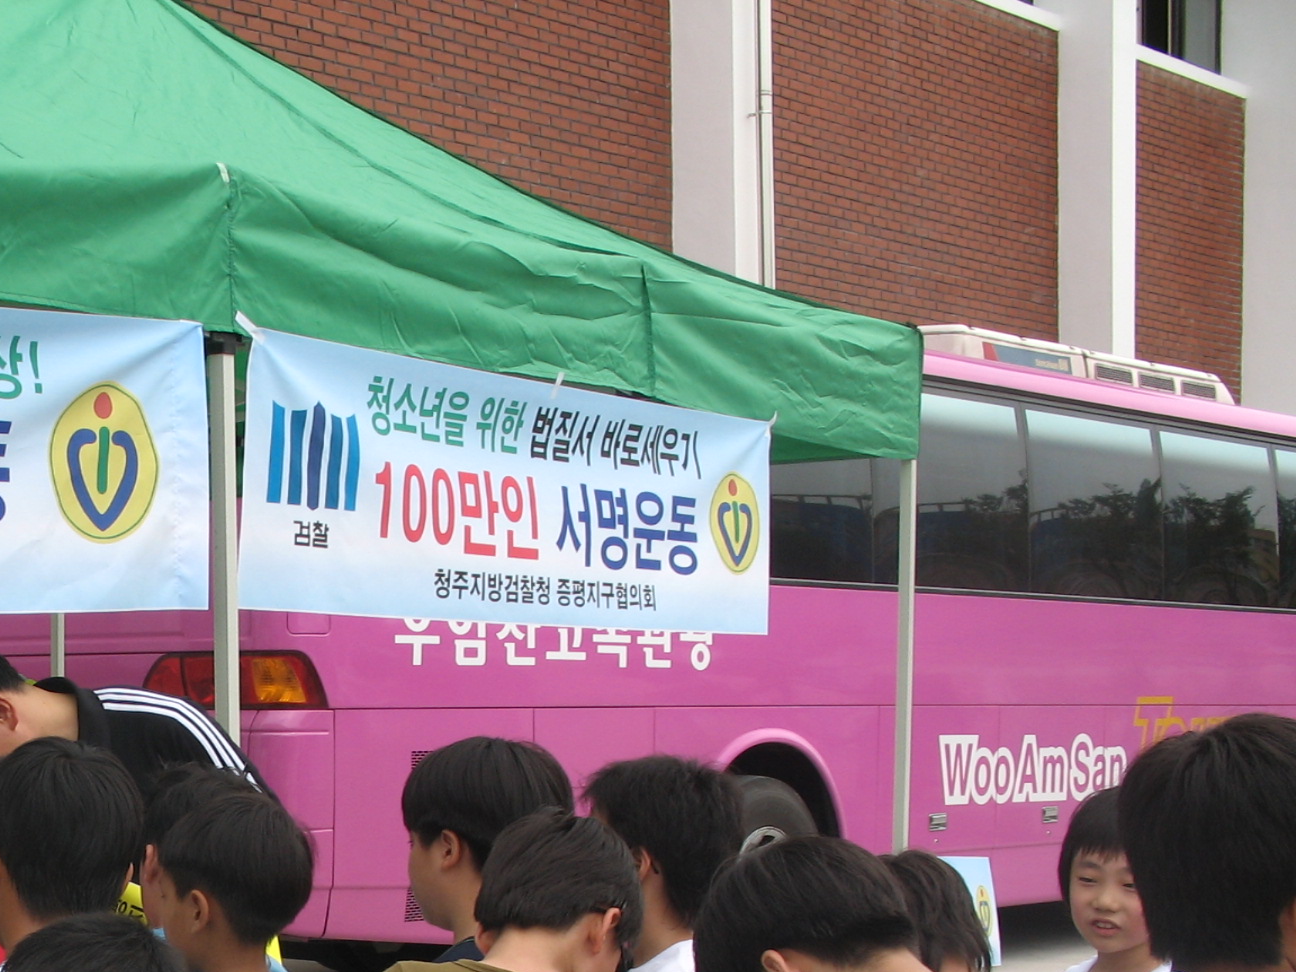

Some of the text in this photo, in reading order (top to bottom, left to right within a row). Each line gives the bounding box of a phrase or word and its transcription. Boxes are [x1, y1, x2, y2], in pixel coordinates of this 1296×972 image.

[366, 375, 702, 479] 청소년을 위한 법질서 바로세우기
[294, 520, 329, 549] 검찰
[375, 461, 699, 575] 100만인 서명운동
[434, 569, 657, 612] 청주지방검찰청 증평지구협의회
